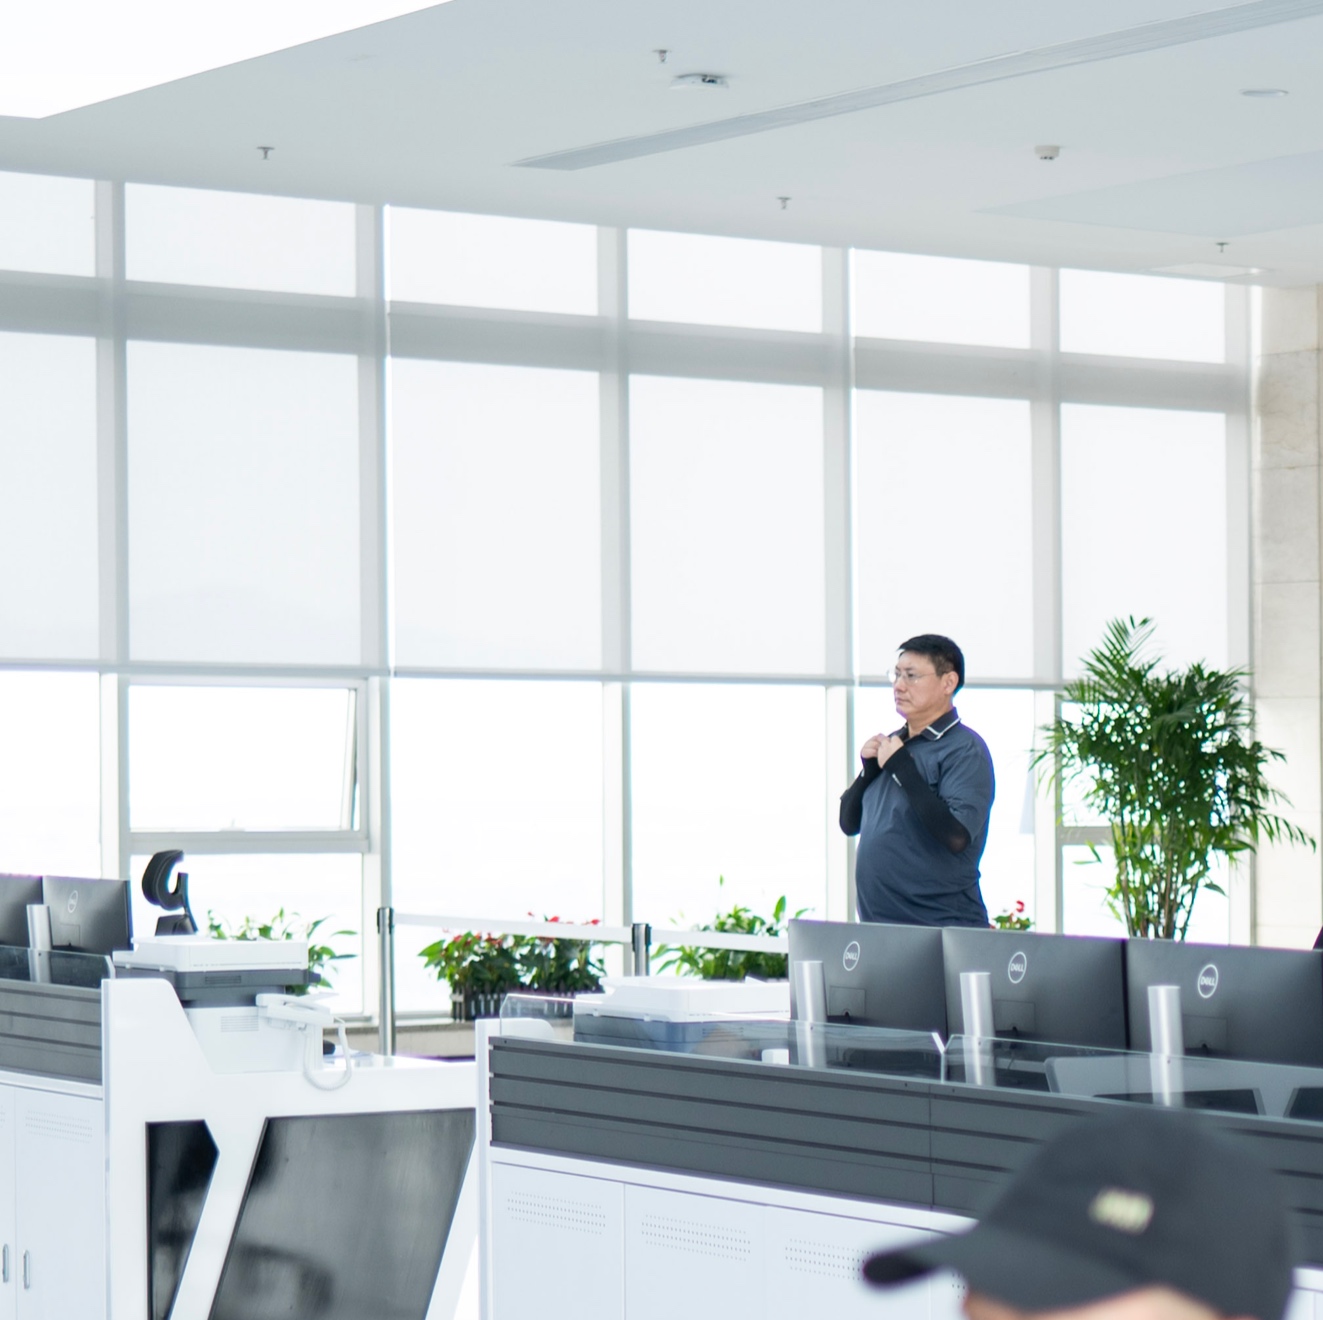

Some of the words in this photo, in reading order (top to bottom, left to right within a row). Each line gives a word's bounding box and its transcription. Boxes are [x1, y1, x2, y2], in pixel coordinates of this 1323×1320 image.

[845, 951, 858, 961] DELL
[1010, 963, 1024, 973] DELL
[1200, 976, 1216, 986] DELL
